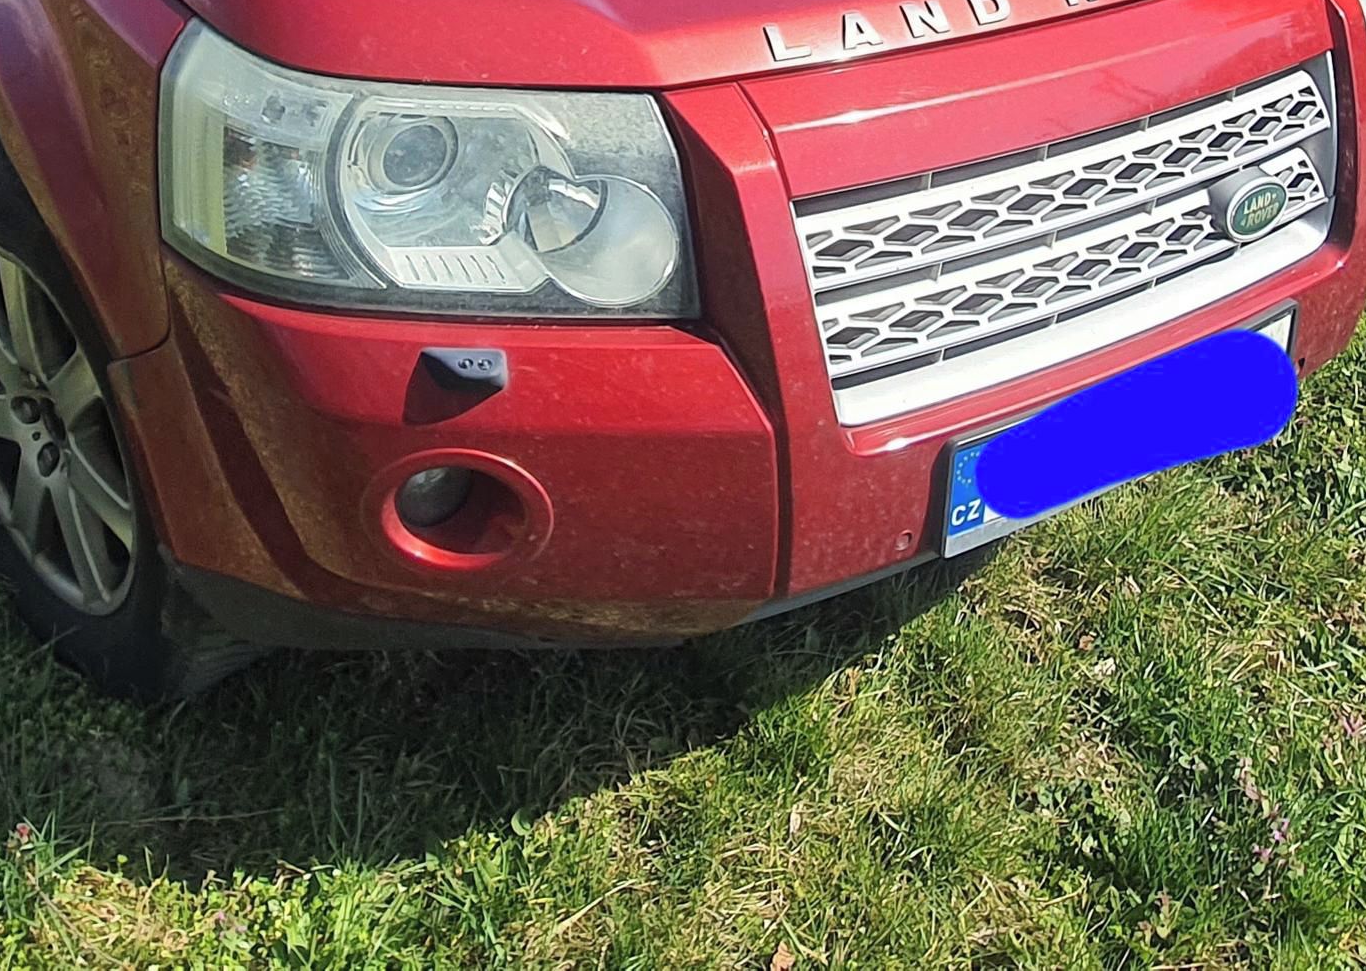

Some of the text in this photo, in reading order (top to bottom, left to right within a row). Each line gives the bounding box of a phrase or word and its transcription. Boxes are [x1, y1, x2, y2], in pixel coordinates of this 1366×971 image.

[1243, 192, 1272, 214] LAND
[1246, 202, 1280, 227] ROVER
[951, 498, 981, 526] CZ
